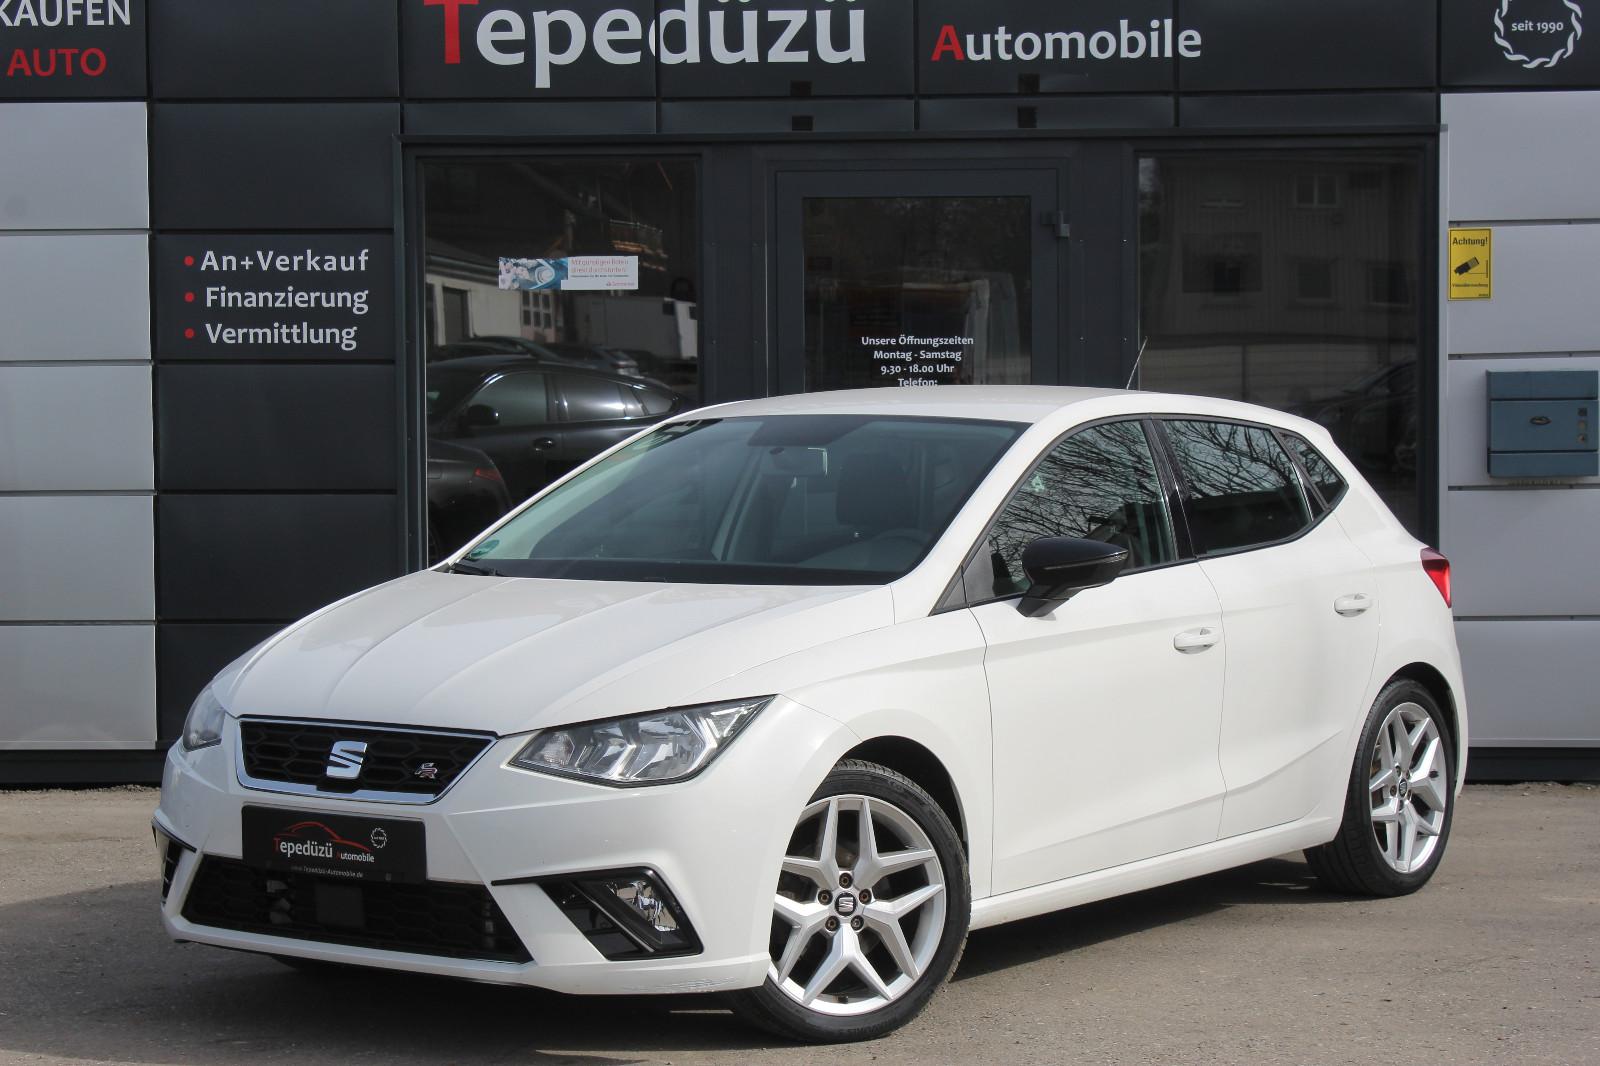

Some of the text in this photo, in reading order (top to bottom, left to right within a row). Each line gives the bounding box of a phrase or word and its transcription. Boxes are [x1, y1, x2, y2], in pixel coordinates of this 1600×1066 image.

[1511, 20, 1564, 34] seit 1990
[423, 0, 866, 88] Tepedüzü
[931, 19, 1202, 61] Automobile
[7, 47, 107, 77] AUTO
[1452, 237, 1488, 247] Achtung!
[200, 249, 369, 272] An+Verkauf
[206, 286, 369, 315] Finanzierung
[205, 322, 358, 351] Vermittlung
[861, 334, 974, 348] Unsere Öffnungszeiten
[873, 350, 913, 362] Montag
[919, 350, 962, 362] Samstag
[880, 365, 901, 376] 9.30
[908, 363, 934, 373] 18.00
[936, 363, 955, 373] Uhr
[898, 378, 938, 387] Telefon:
[273, 837, 333, 858] Tepedüzü
[336, 852, 375, 863] Automobile
